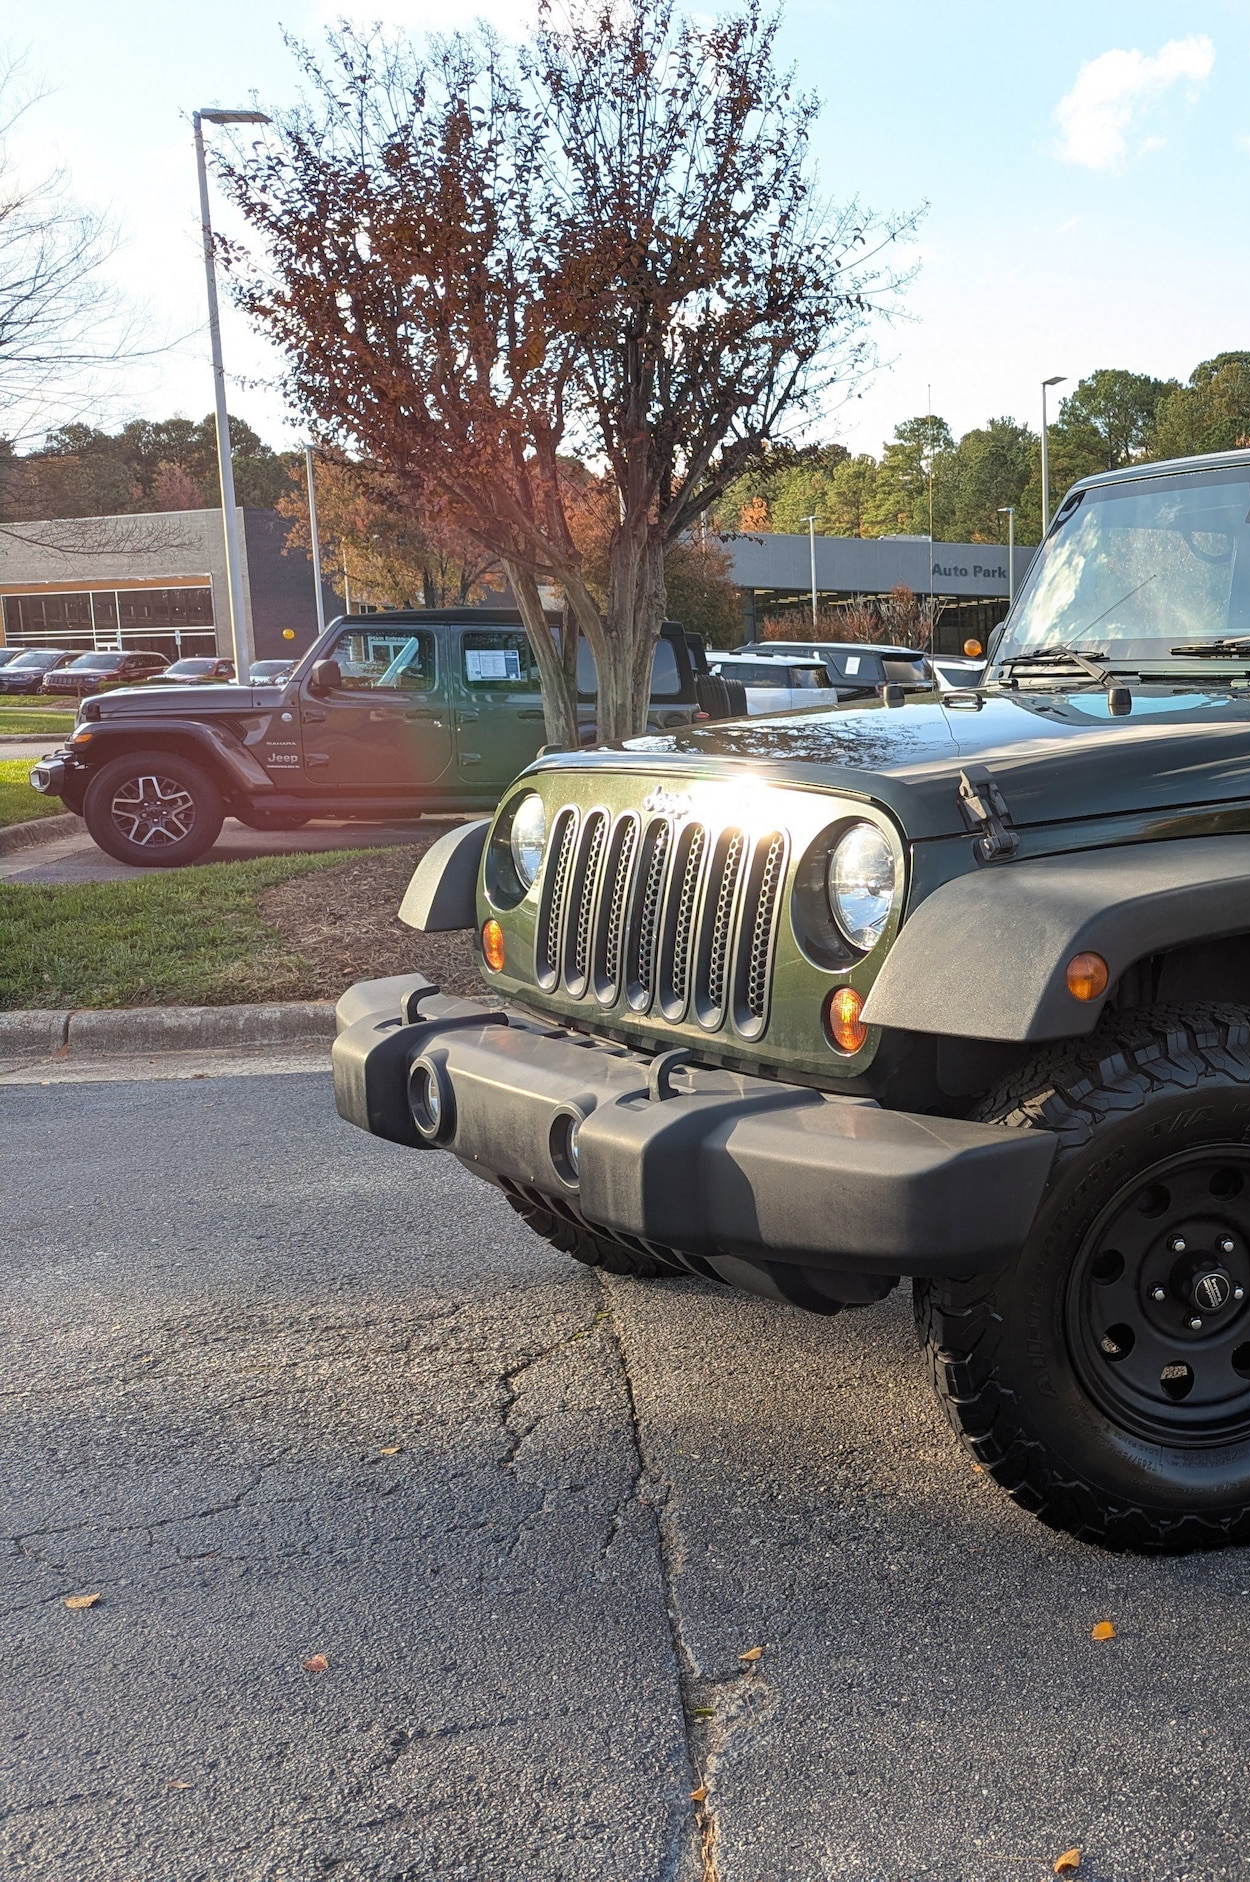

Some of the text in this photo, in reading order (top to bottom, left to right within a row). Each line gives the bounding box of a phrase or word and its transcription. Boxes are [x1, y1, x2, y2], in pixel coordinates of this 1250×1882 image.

[932, 564, 1007, 579] Auto Park
[267, 752, 298, 764] Jeep
